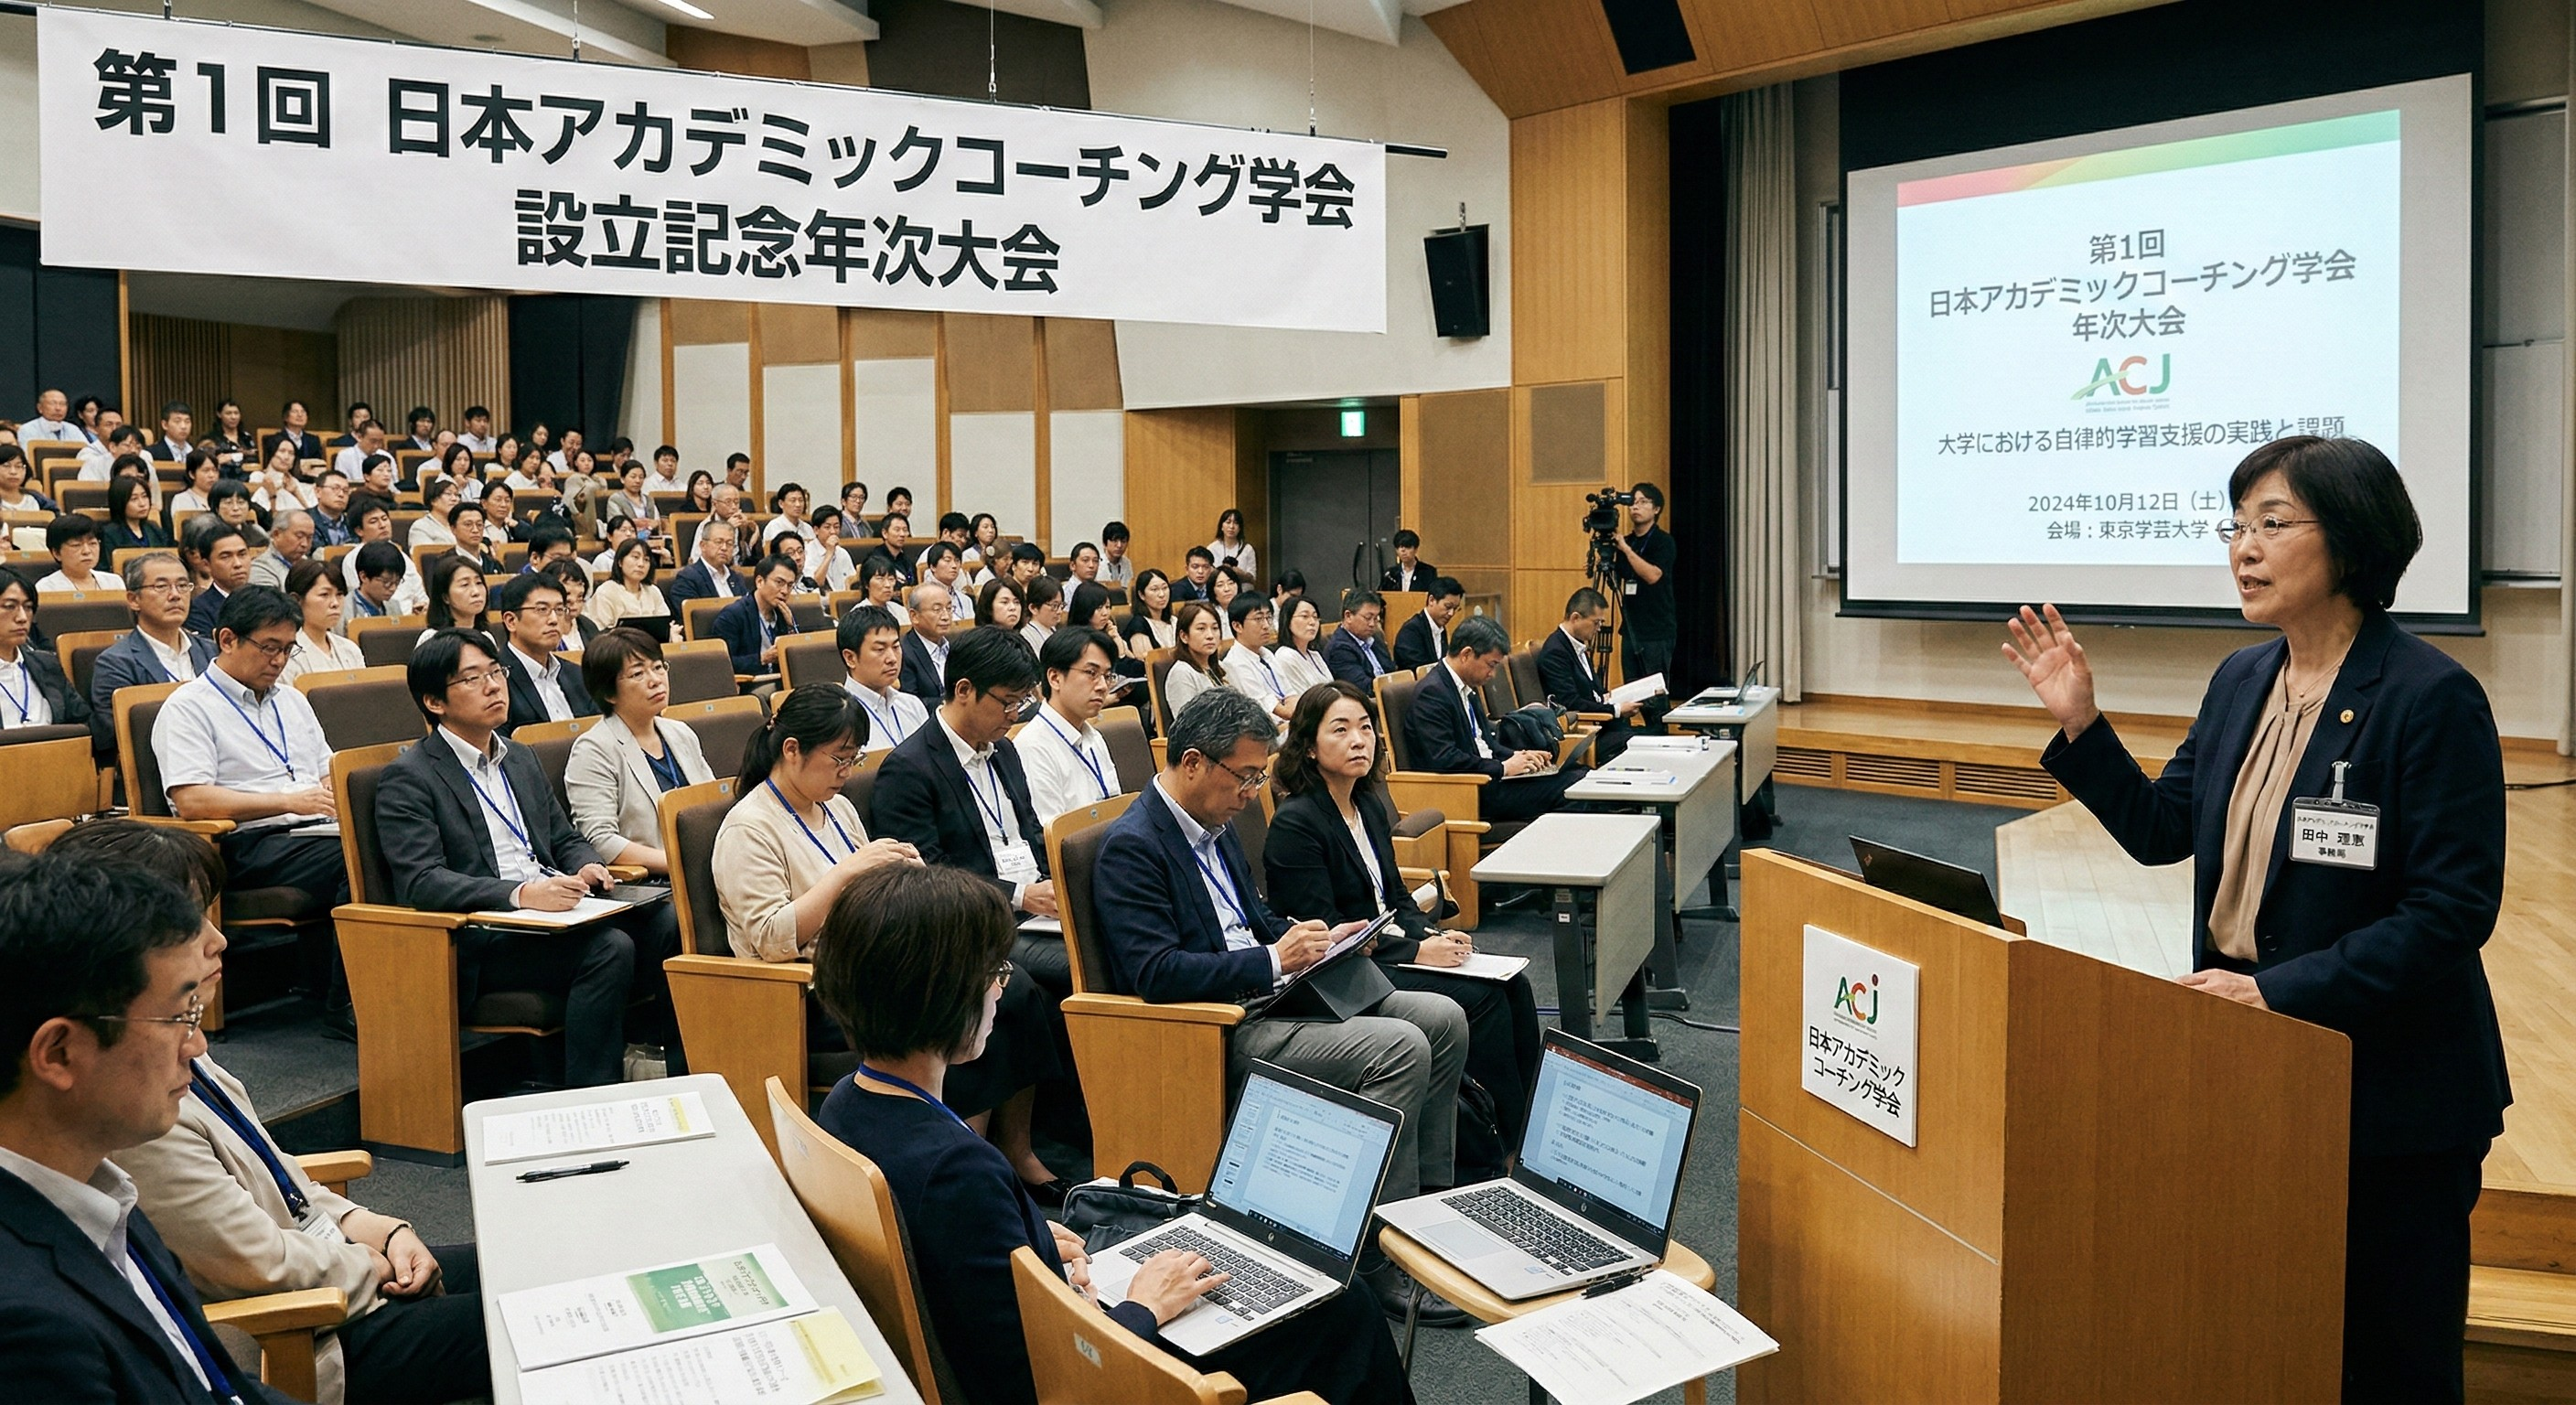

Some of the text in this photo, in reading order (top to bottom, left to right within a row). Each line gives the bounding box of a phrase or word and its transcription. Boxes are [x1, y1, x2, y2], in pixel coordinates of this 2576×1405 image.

[92, 48, 1356, 230] 第1回 日本アカデミックコーチング学会
[514, 188, 1061, 295] 設立記念年次大会
[2089, 229, 2164, 264] 第1回
[1930, 249, 2356, 318] 日本アカデミックコーチング学会
[2072, 305, 2186, 342] 年次大会
[2085, 353, 2171, 397] ACJ
[2302, 828, 2329, 843] 田中
[1809, 1025, 1905, 1087] 日本アカデミック
[1814, 1056, 1902, 1119] コーチング学会
